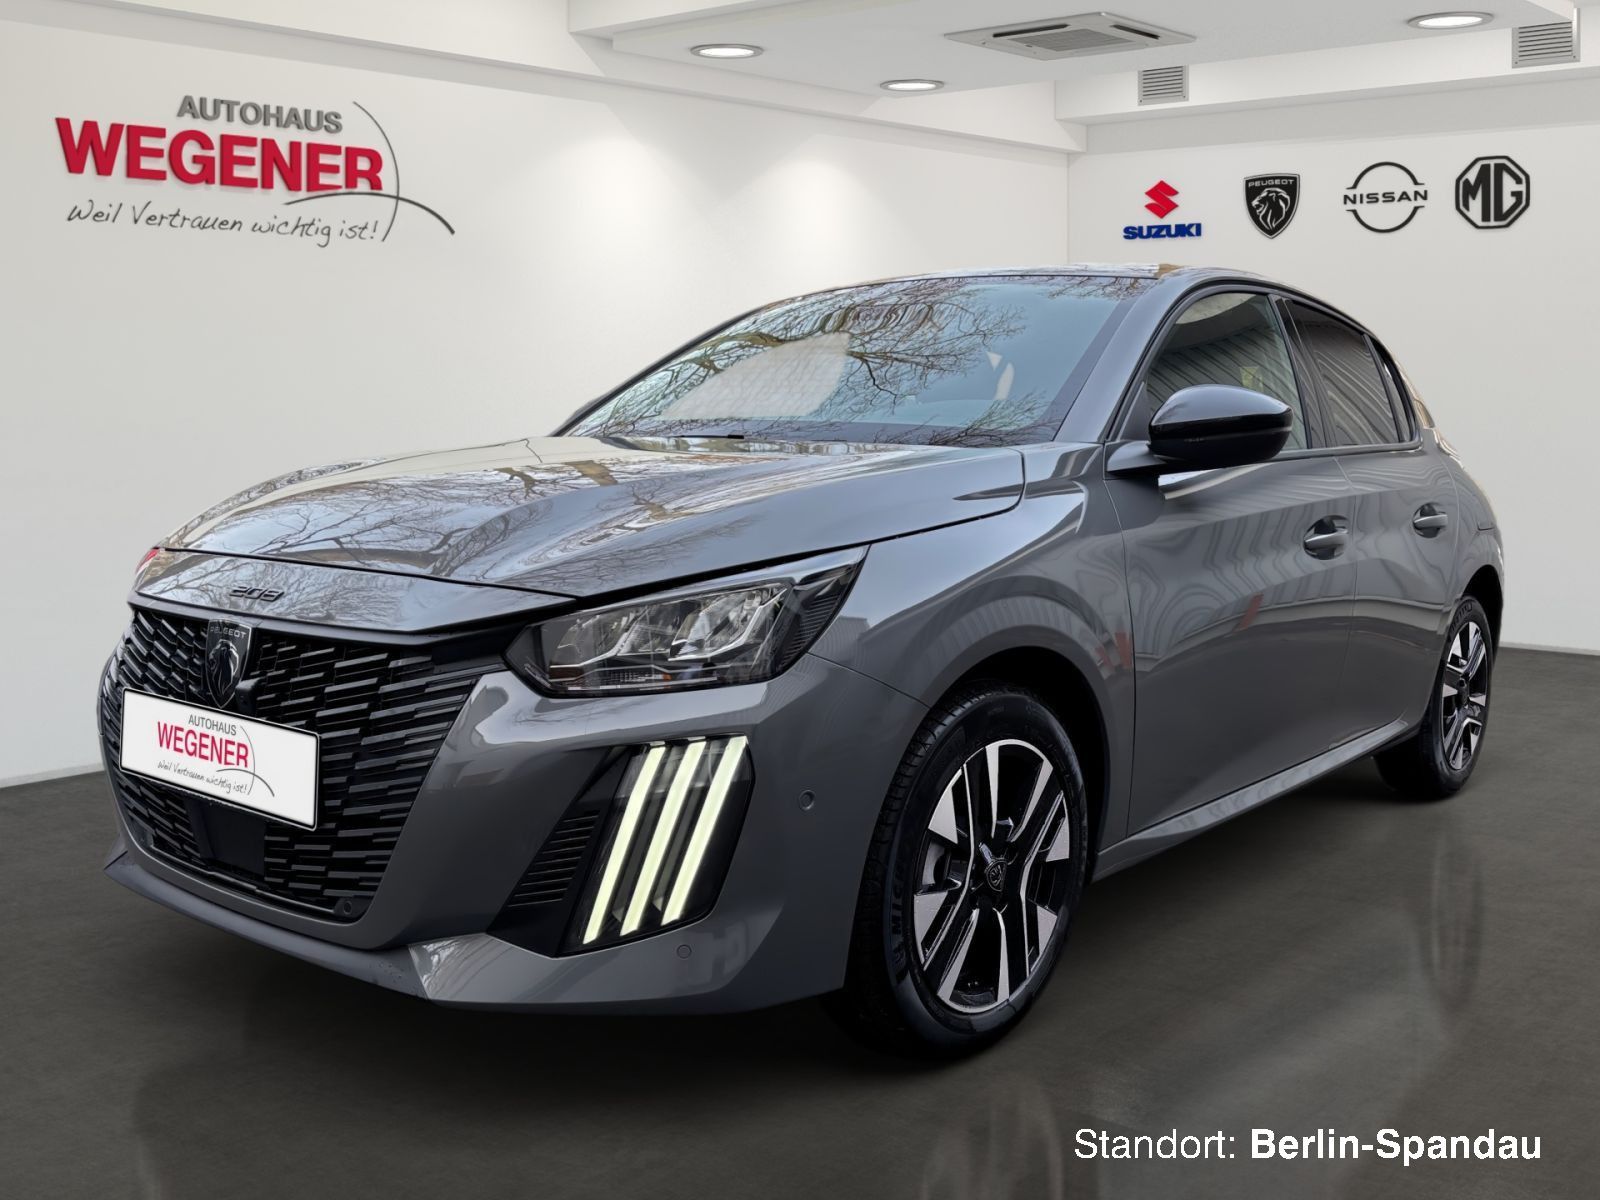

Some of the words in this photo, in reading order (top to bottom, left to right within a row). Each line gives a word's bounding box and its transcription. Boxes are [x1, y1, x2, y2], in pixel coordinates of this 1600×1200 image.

[176, 95, 343, 134] AUTOHAUS
[55, 117, 383, 192] WEGENER
[1248, 178, 1296, 188] PEUGEOT
[1343, 189, 1429, 206] NISSAN
[1462, 162, 1524, 223] MG
[67, 199, 123, 224] Weil
[131, 200, 243, 231] Vertrauen
[251, 215, 333, 248] wichtig
[339, 220, 379, 241] ist!
[1123, 223, 1202, 240] SUZUKI
[157, 721, 249, 768] WEGENER
[188, 714, 237, 736] AUTOHAUS
